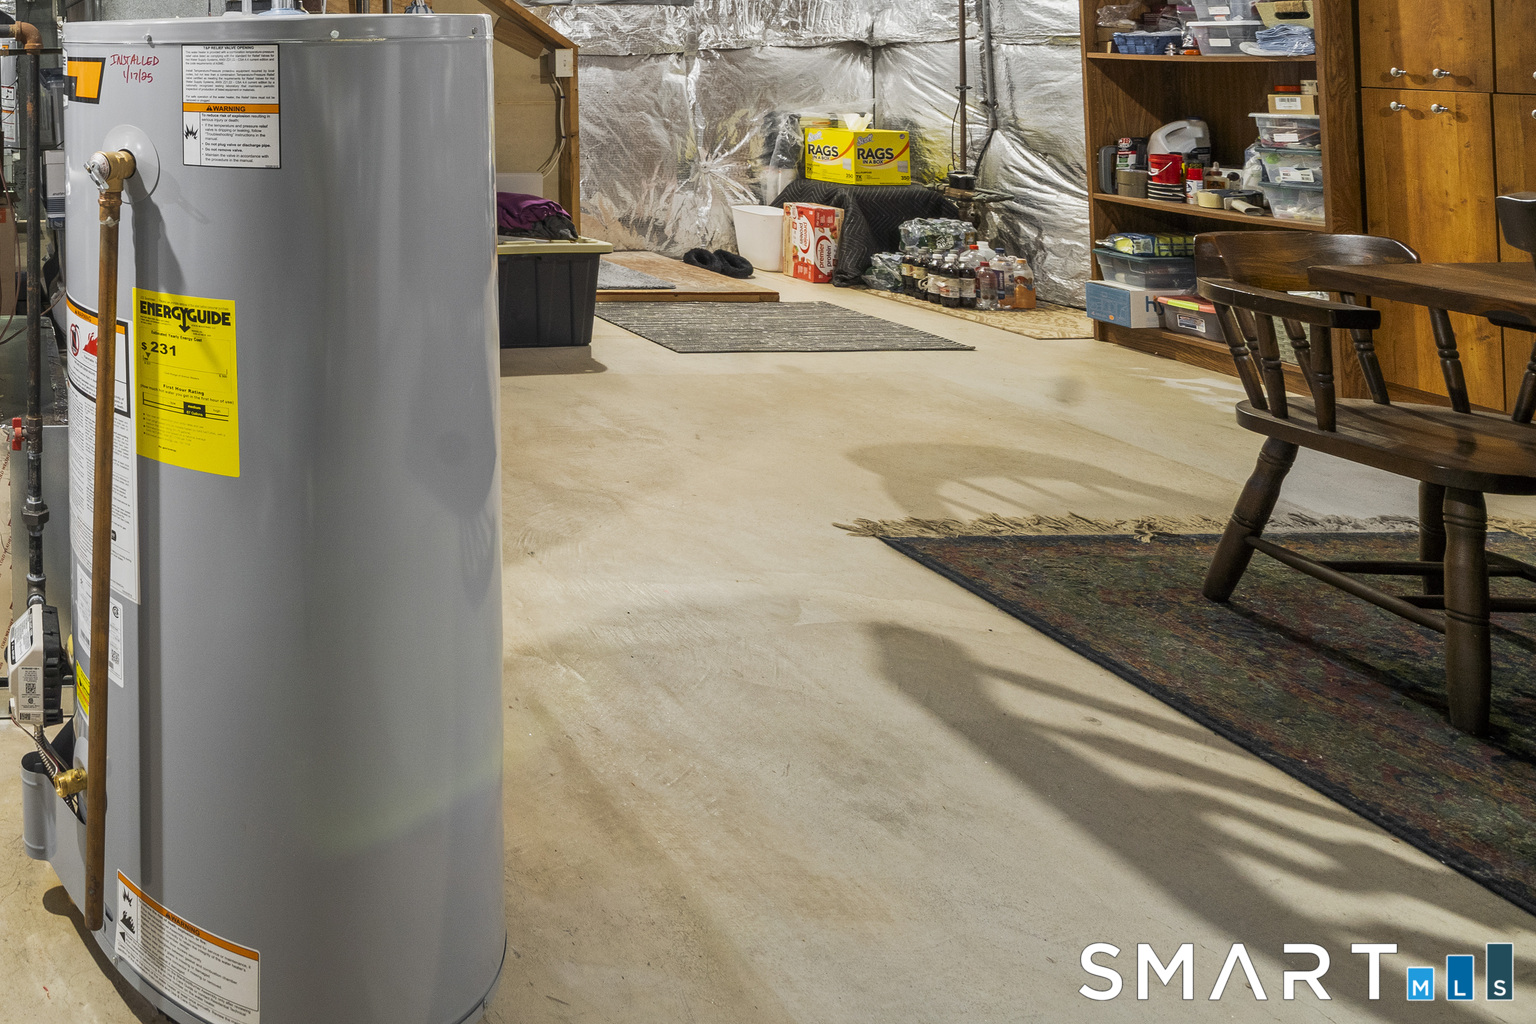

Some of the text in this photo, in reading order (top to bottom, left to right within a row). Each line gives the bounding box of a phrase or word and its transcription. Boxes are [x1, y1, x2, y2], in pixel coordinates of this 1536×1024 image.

[110, 53, 160, 67] INSTALLED
[122, 65, 154, 83] 1/17/25
[856, 133, 874, 147] Scott
[807, 143, 839, 157] RAGS
[857, 147, 894, 160] RAGS
[139, 300, 231, 326] ENERGYGUIDE
[141, 341, 176, 357] $ 231
[187, 388, 205, 396] Rating
[171, 915, 200, 936] WARNING
